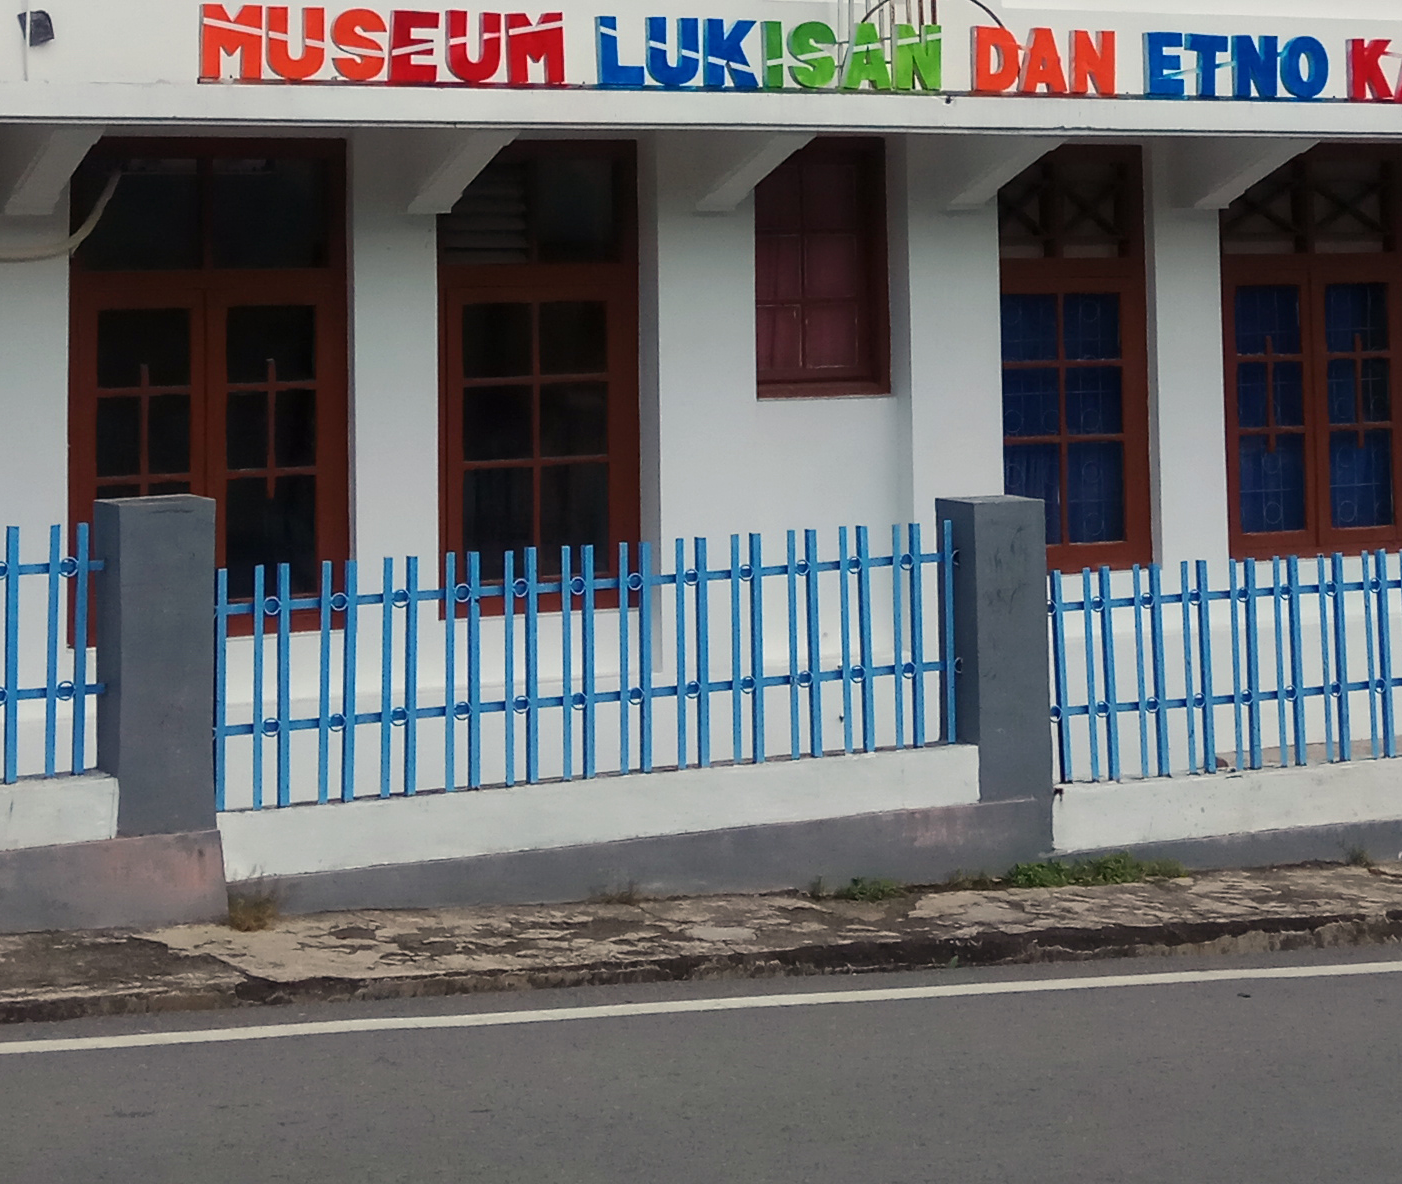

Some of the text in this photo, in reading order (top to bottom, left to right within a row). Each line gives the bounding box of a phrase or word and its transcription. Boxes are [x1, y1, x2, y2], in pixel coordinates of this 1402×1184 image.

[200, 3, 565, 84] MUSEUM
[594, 15, 943, 92] LUKISAN
[970, 24, 1117, 96] DAN
[1142, 31, 1329, 100] ETNO
